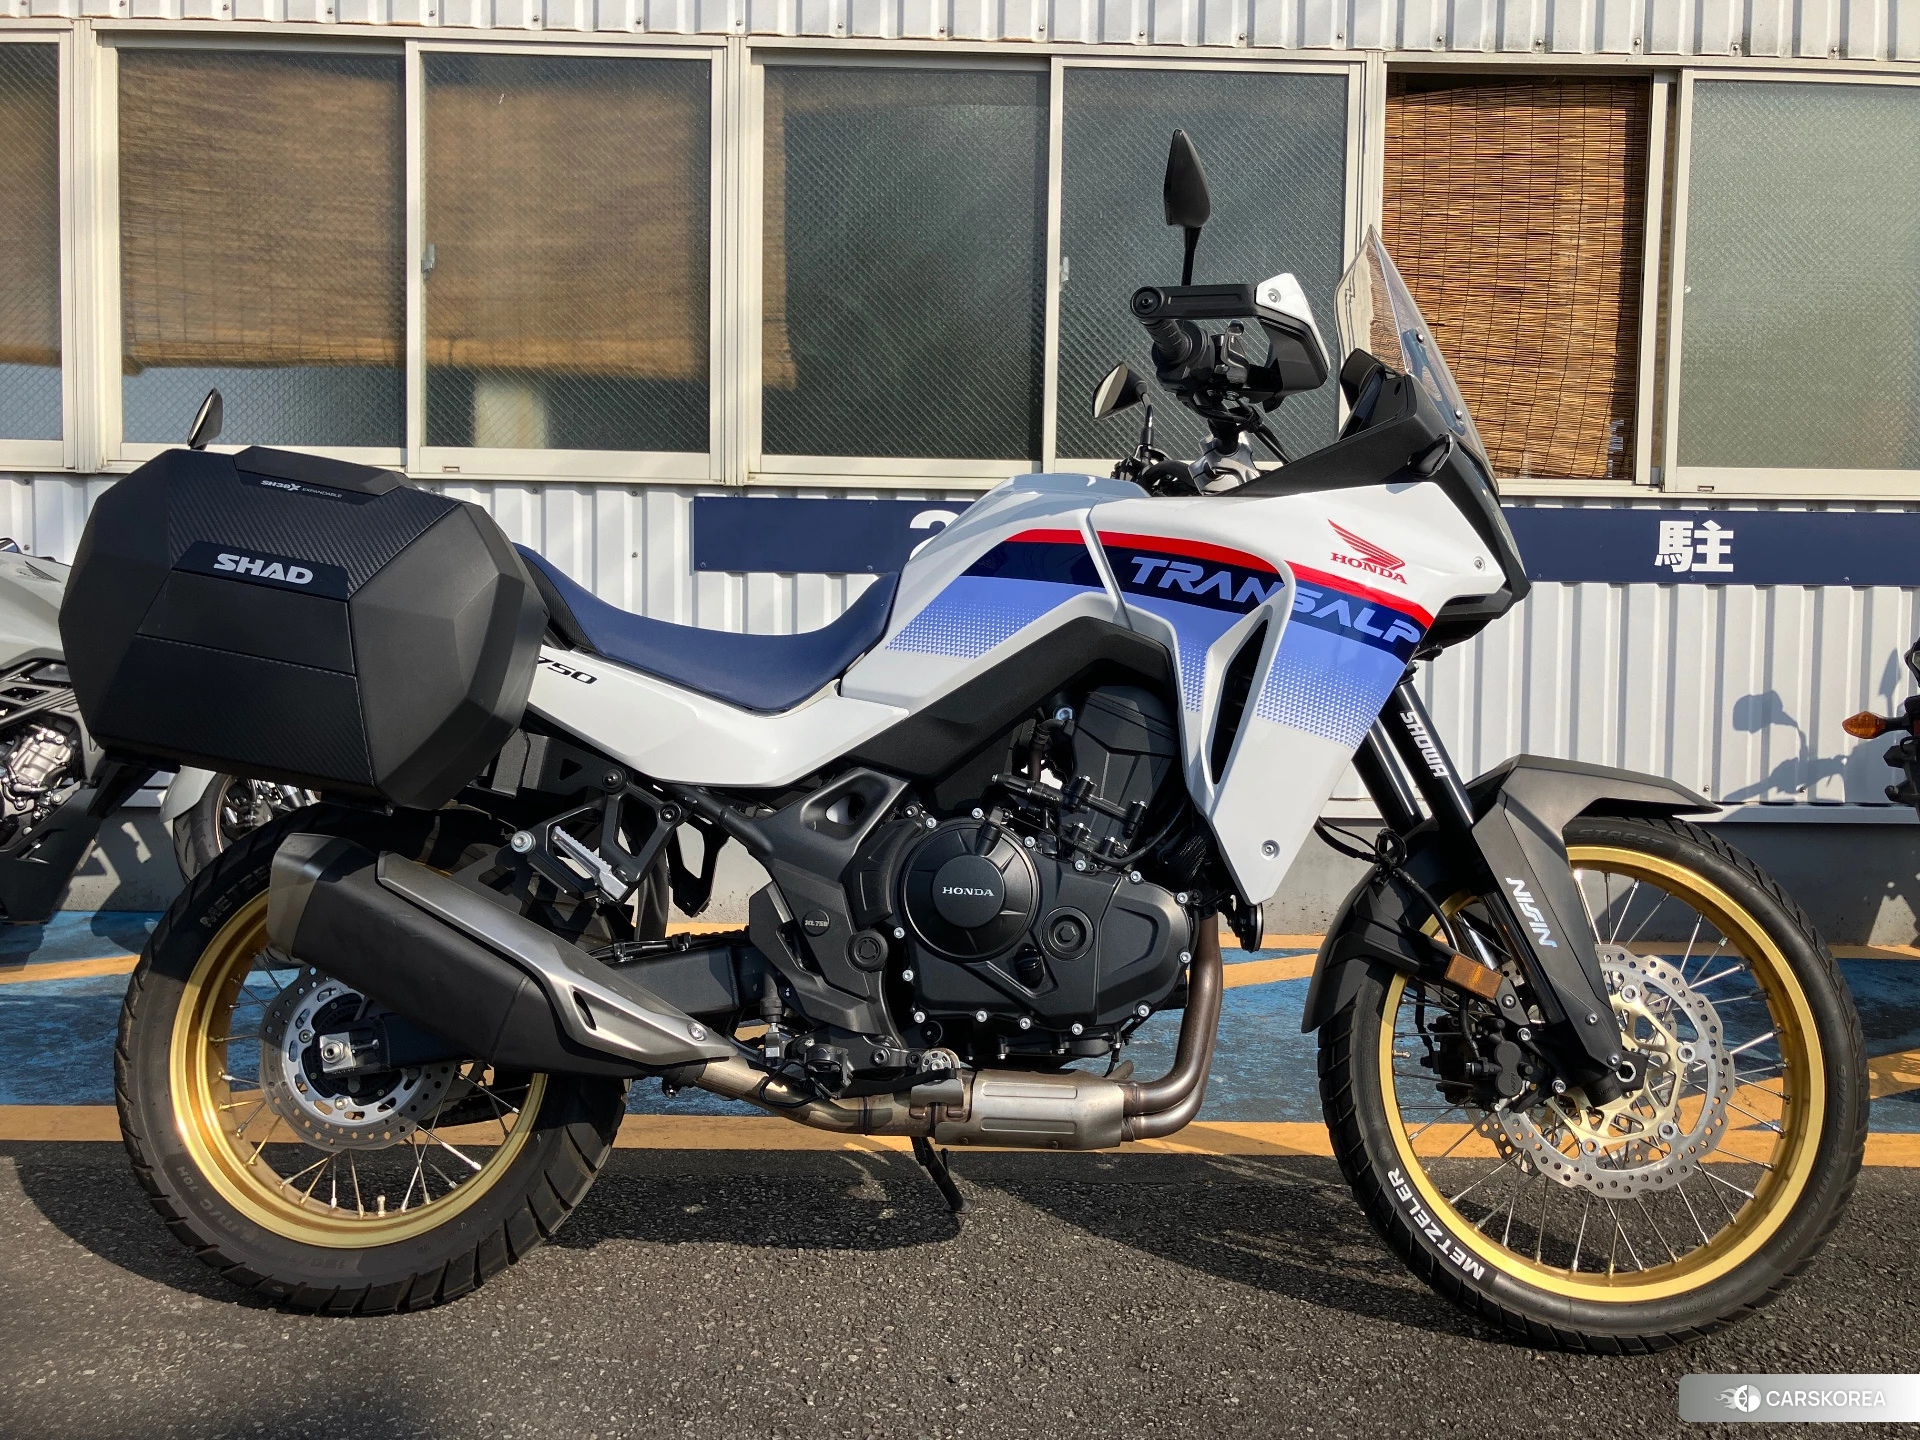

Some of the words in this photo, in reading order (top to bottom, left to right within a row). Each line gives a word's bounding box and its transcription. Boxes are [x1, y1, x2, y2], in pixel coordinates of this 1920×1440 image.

[213, 553, 314, 585] SHAD
[1331, 551, 1408, 585] HONDA
[1654, 519, 1734, 573] 駐
[1131, 556, 1421, 644] TRANSALP
[1400, 711, 1450, 778] SHOWA
[942, 886, 995, 897] HONDA
[1387, 1167, 1485, 1281] METZELER
